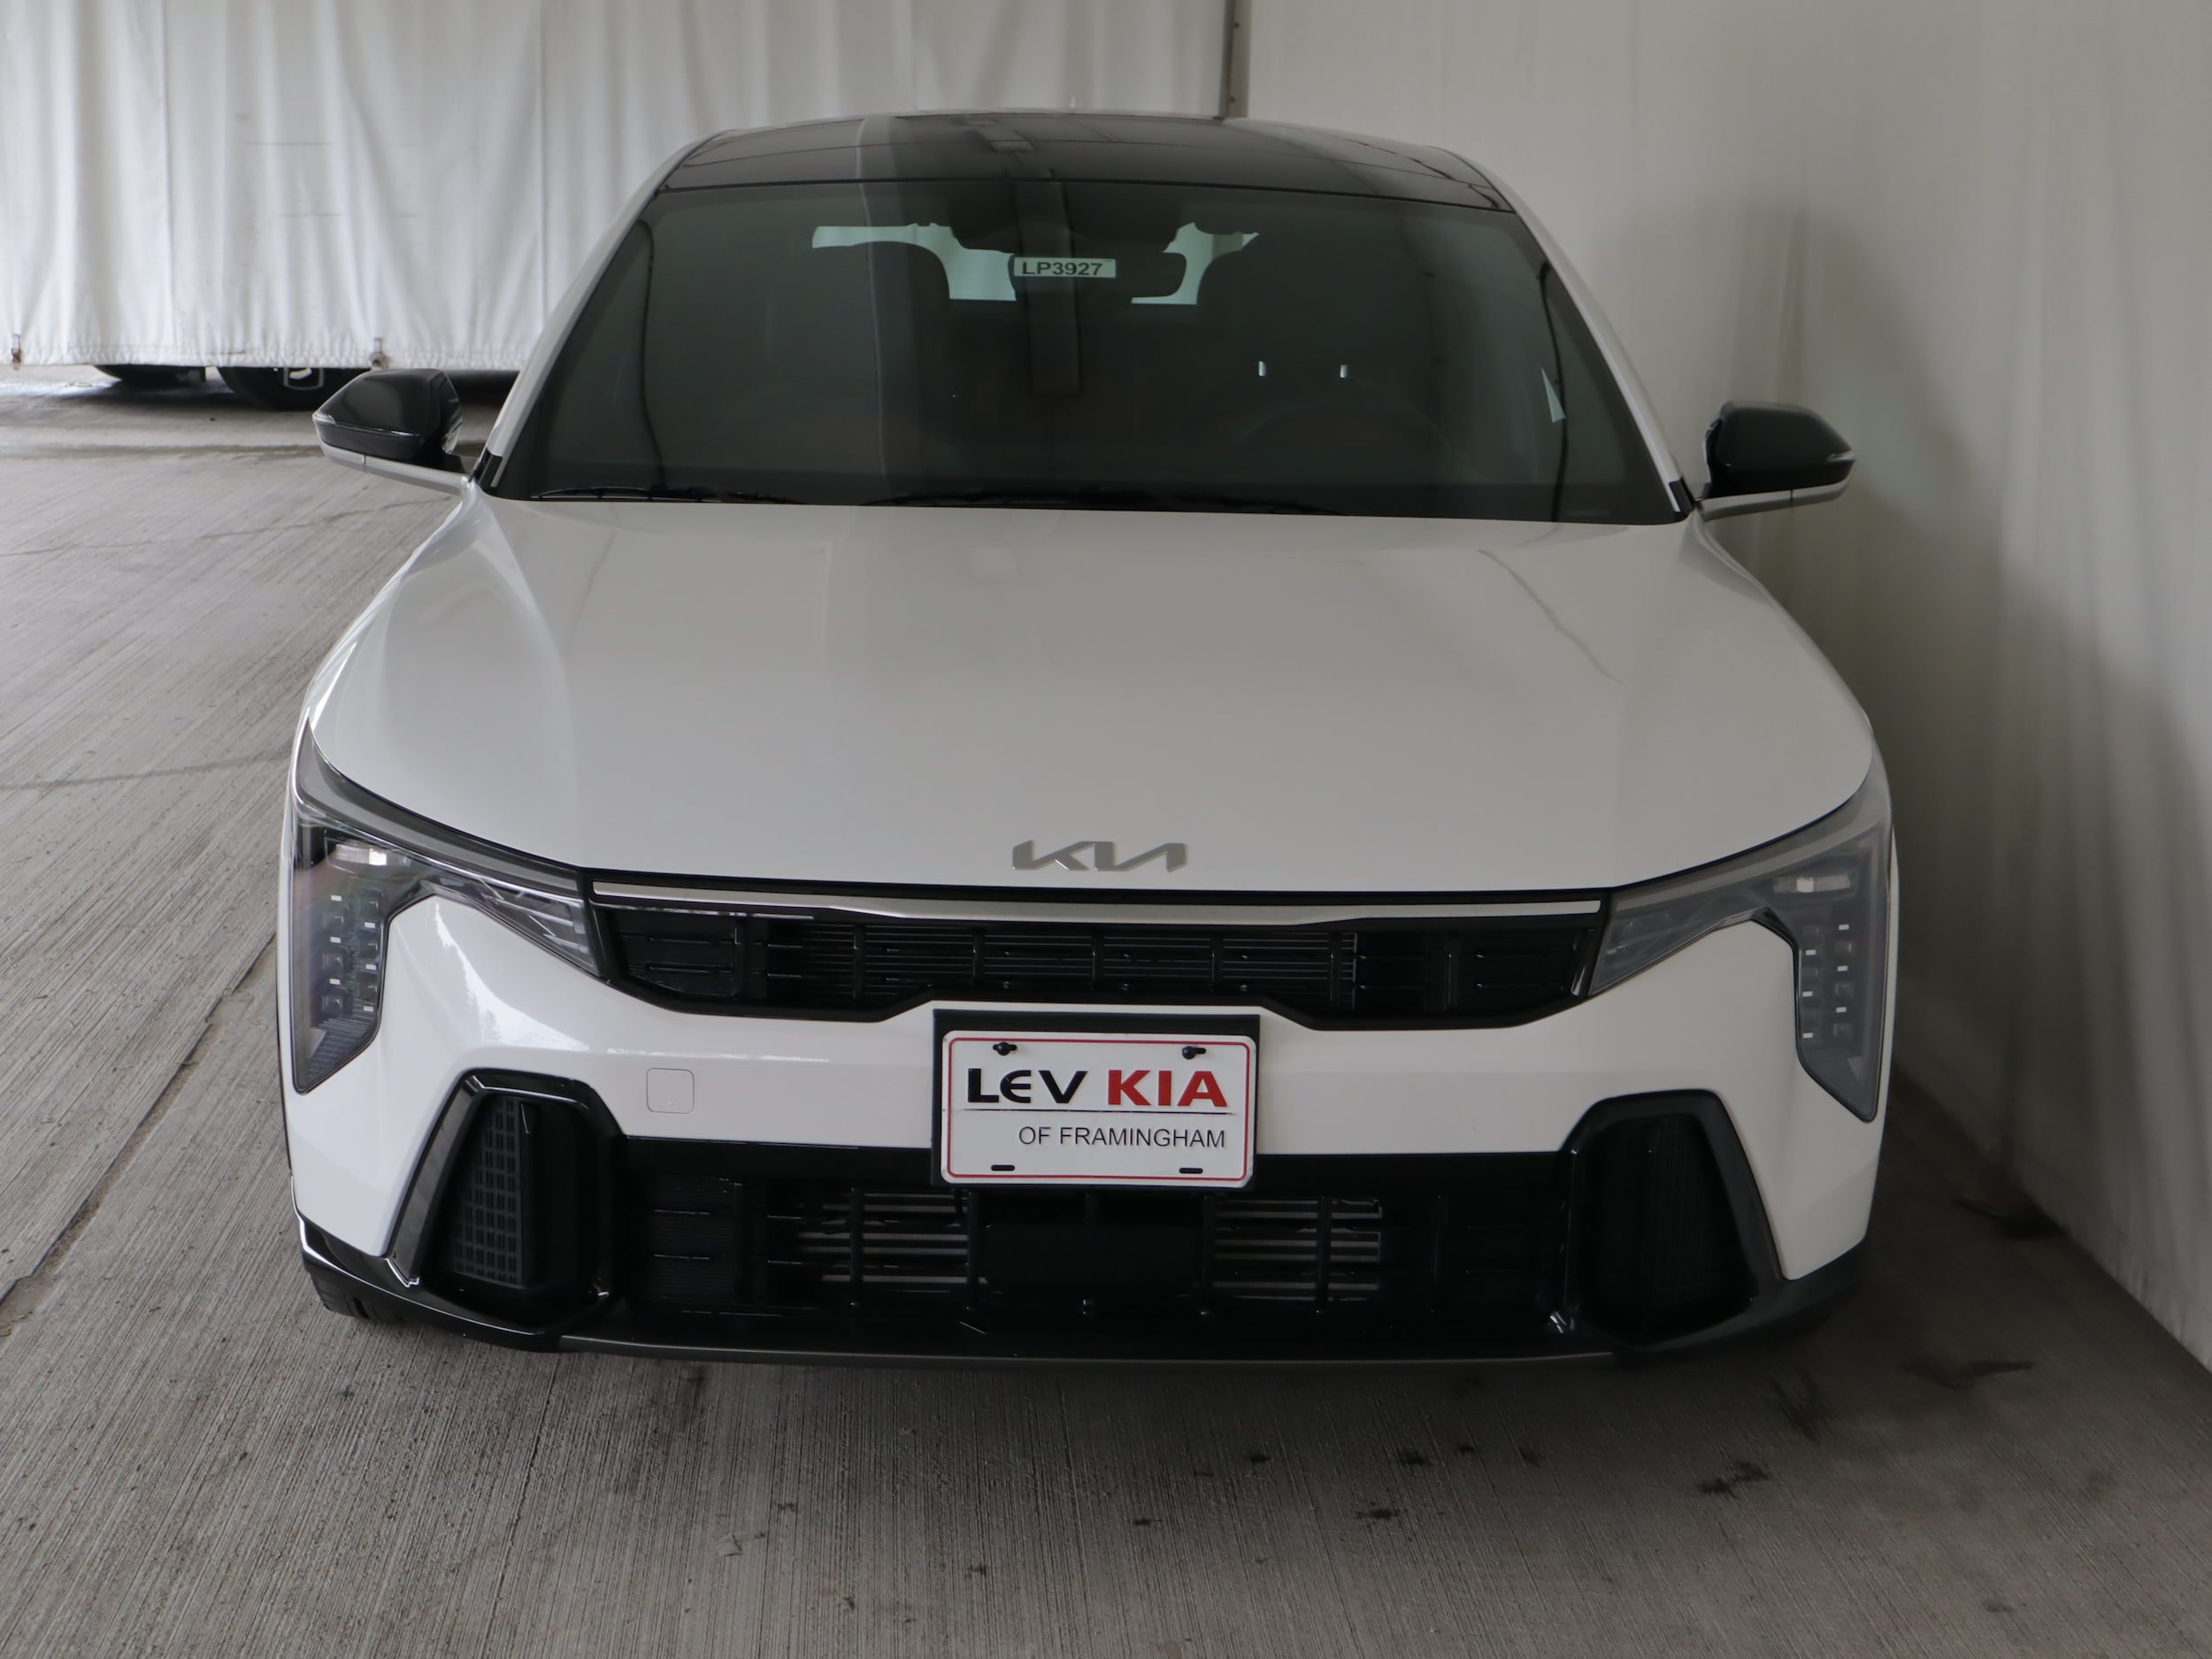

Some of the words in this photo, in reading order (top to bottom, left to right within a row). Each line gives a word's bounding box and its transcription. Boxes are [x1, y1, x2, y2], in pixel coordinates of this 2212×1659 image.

[1022, 261, 1102, 276] LP3927
[1012, 840, 1187, 872] KIA
[968, 1068, 1088, 1103] LEV
[1108, 1070, 1228, 1107] KIA
[1018, 1126, 1051, 1145] OF
[1060, 1126, 1225, 1148] FRAMINGHAM
